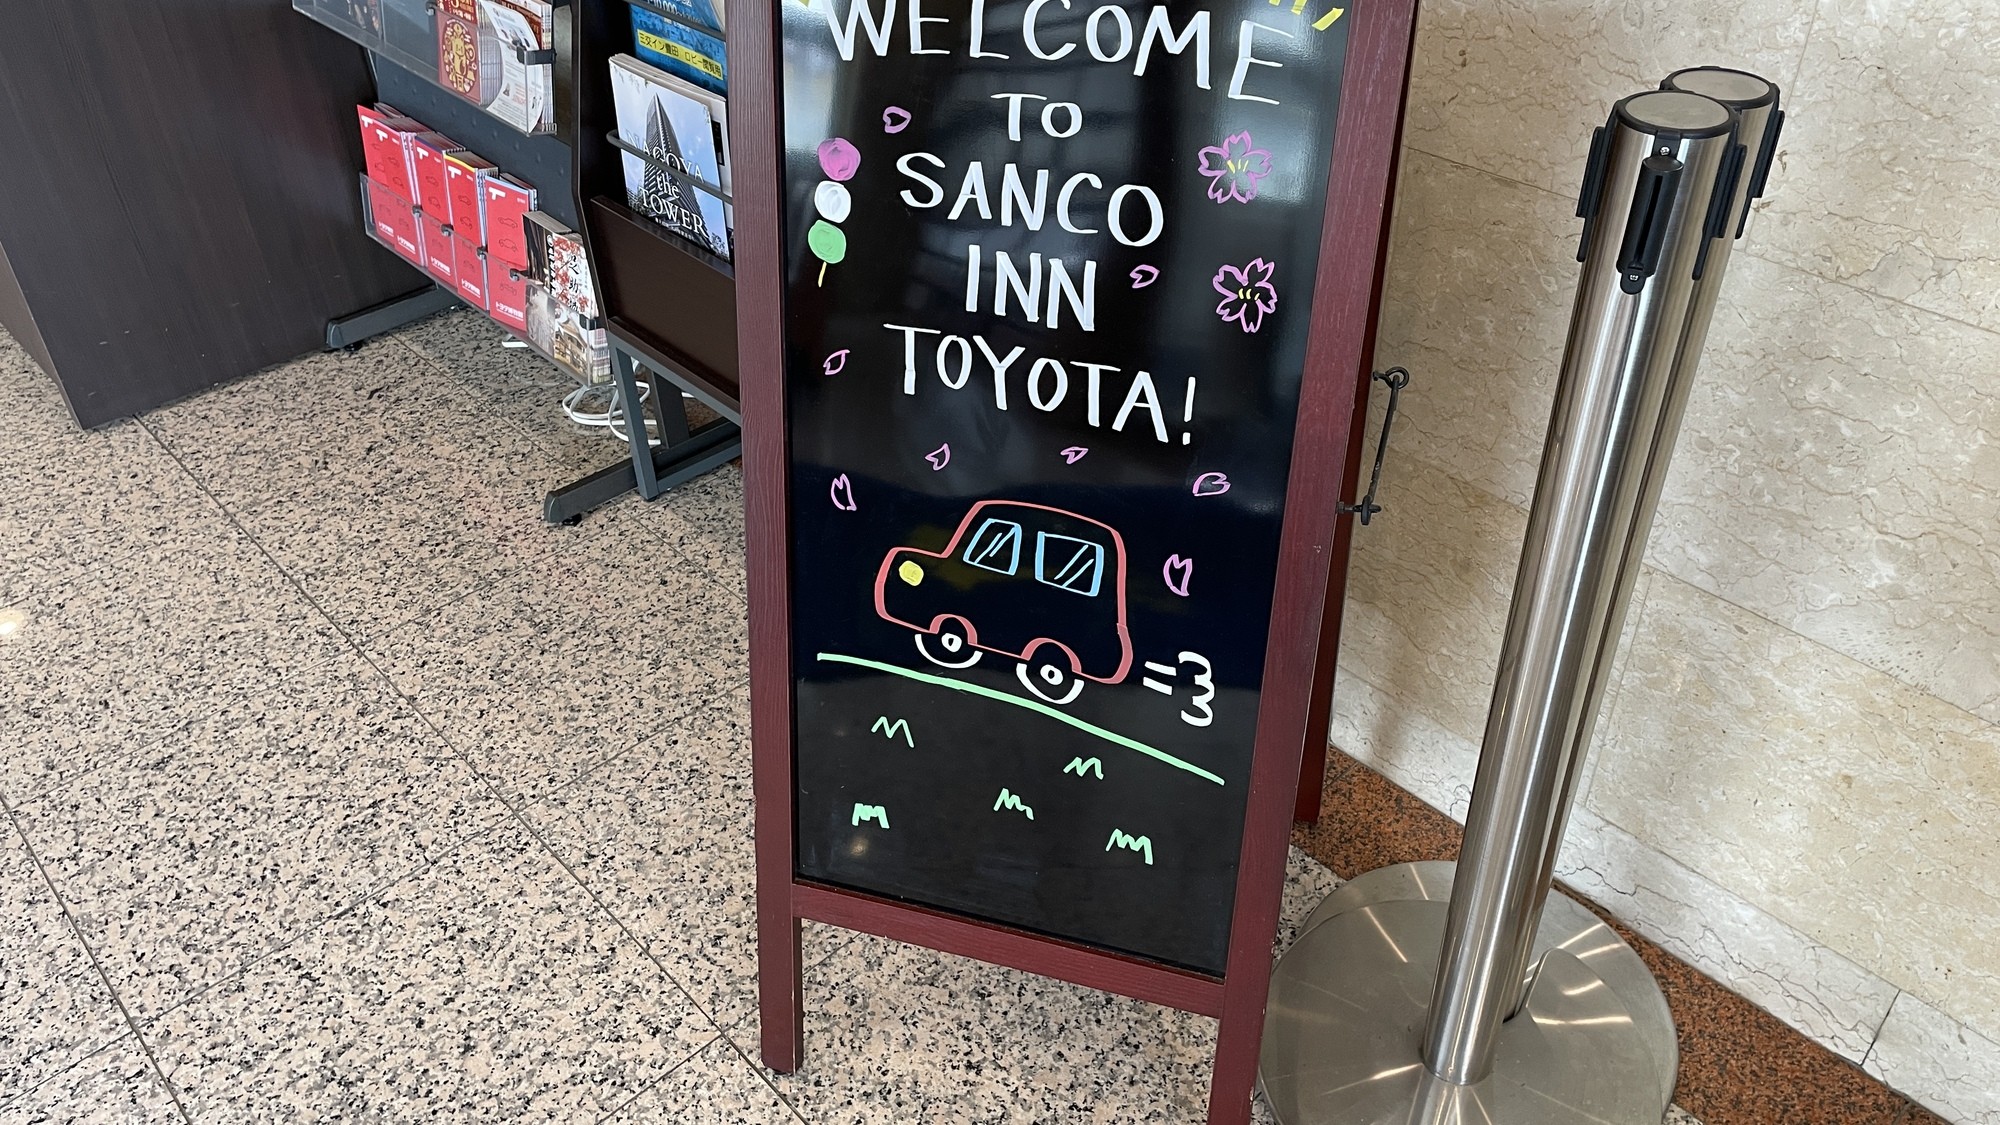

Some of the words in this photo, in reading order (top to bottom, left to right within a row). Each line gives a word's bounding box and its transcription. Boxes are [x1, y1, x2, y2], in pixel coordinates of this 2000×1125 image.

[823, 0, 1297, 105] WELCOME
[626, 129, 704, 183] NAGOYA
[656, 170, 680, 198] the
[896, 152, 1164, 247] SANCO
[639, 187, 710, 239] TOWER
[966, 244, 1097, 332] INN
[883, 323, 1196, 445] TOYOTA!
